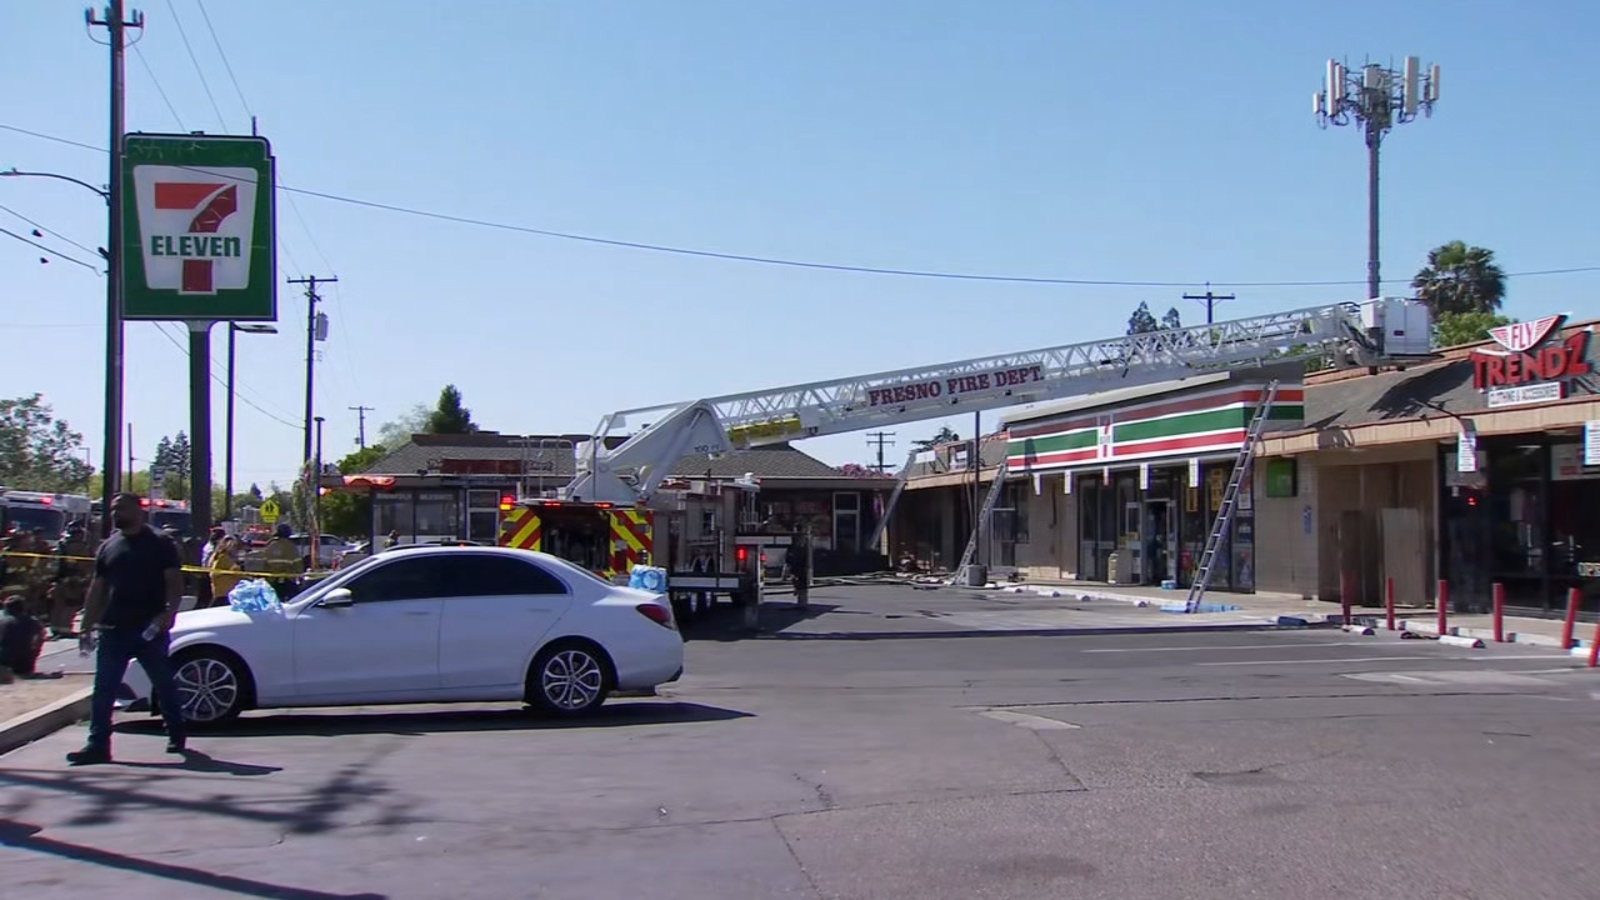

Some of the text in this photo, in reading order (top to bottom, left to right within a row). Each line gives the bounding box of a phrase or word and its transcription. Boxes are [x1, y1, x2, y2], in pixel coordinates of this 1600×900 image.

[154, 182, 238, 292] 7
[1470, 331, 1590, 389] TRENDZ
[1511, 323, 1535, 349] FLY
[868, 366, 1045, 406] FRESNO FIRE DEPT.
